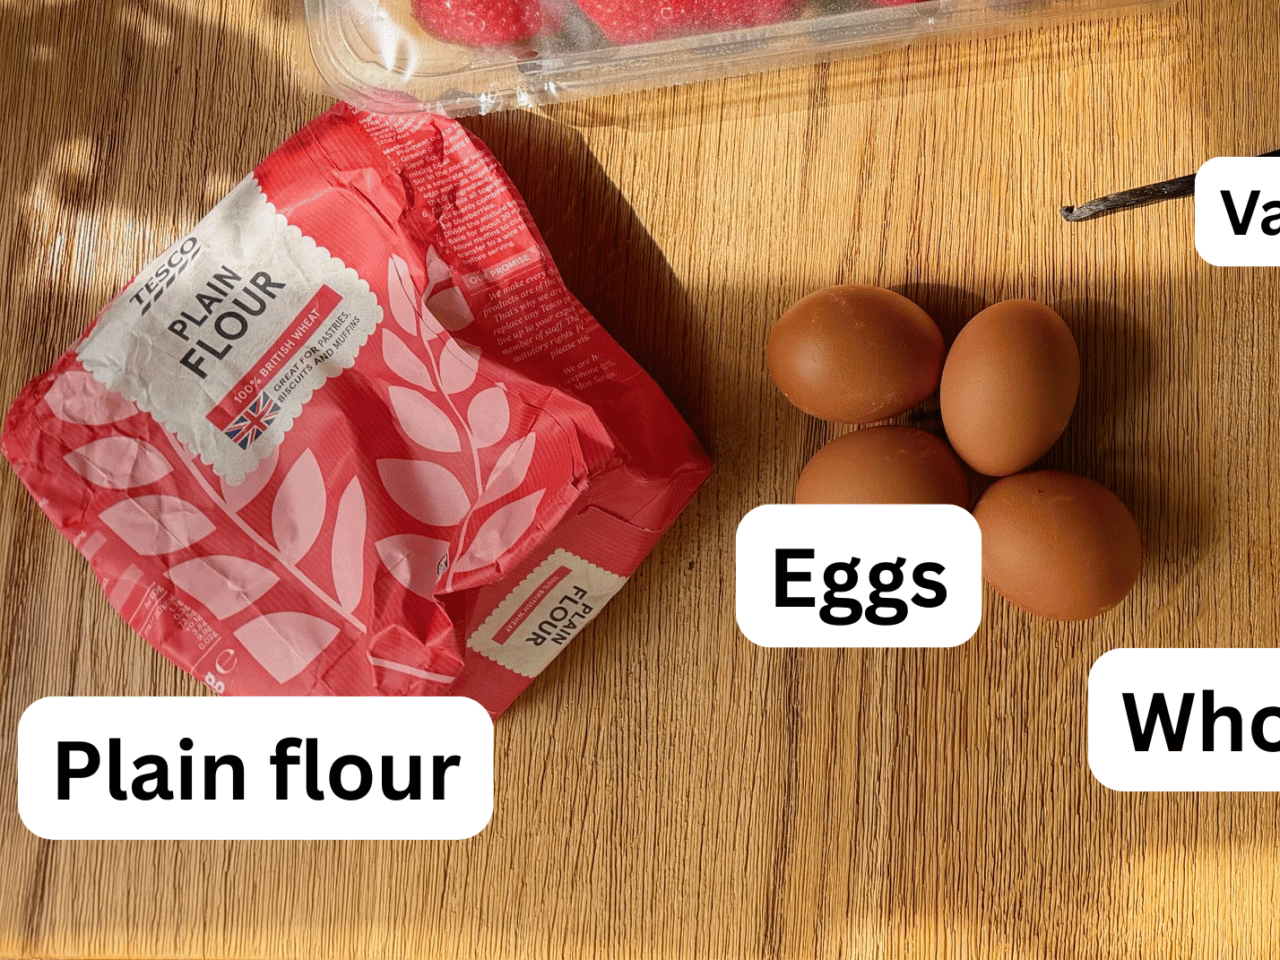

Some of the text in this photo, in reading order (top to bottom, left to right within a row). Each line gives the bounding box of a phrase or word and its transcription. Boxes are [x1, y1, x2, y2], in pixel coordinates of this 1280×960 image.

[128, 232, 200, 310] TESCO
[487, 269, 547, 301] We make every
[488, 252, 531, 277] PROMISE
[519, 287, 535, 298] are
[166, 262, 243, 344] PLAIN
[177, 264, 288, 382] FLOUR
[232, 307, 322, 405] 100% BRITISH WHEAT
[272, 308, 352, 392] GREAT FOR PASTRIES,
[276, 314, 363, 403] BISCUITS AND MUFFINS
[522, 588, 545, 611] BRITISH
[524, 585, 587, 648] FLOUR
[550, 602, 593, 646] PLAIN
